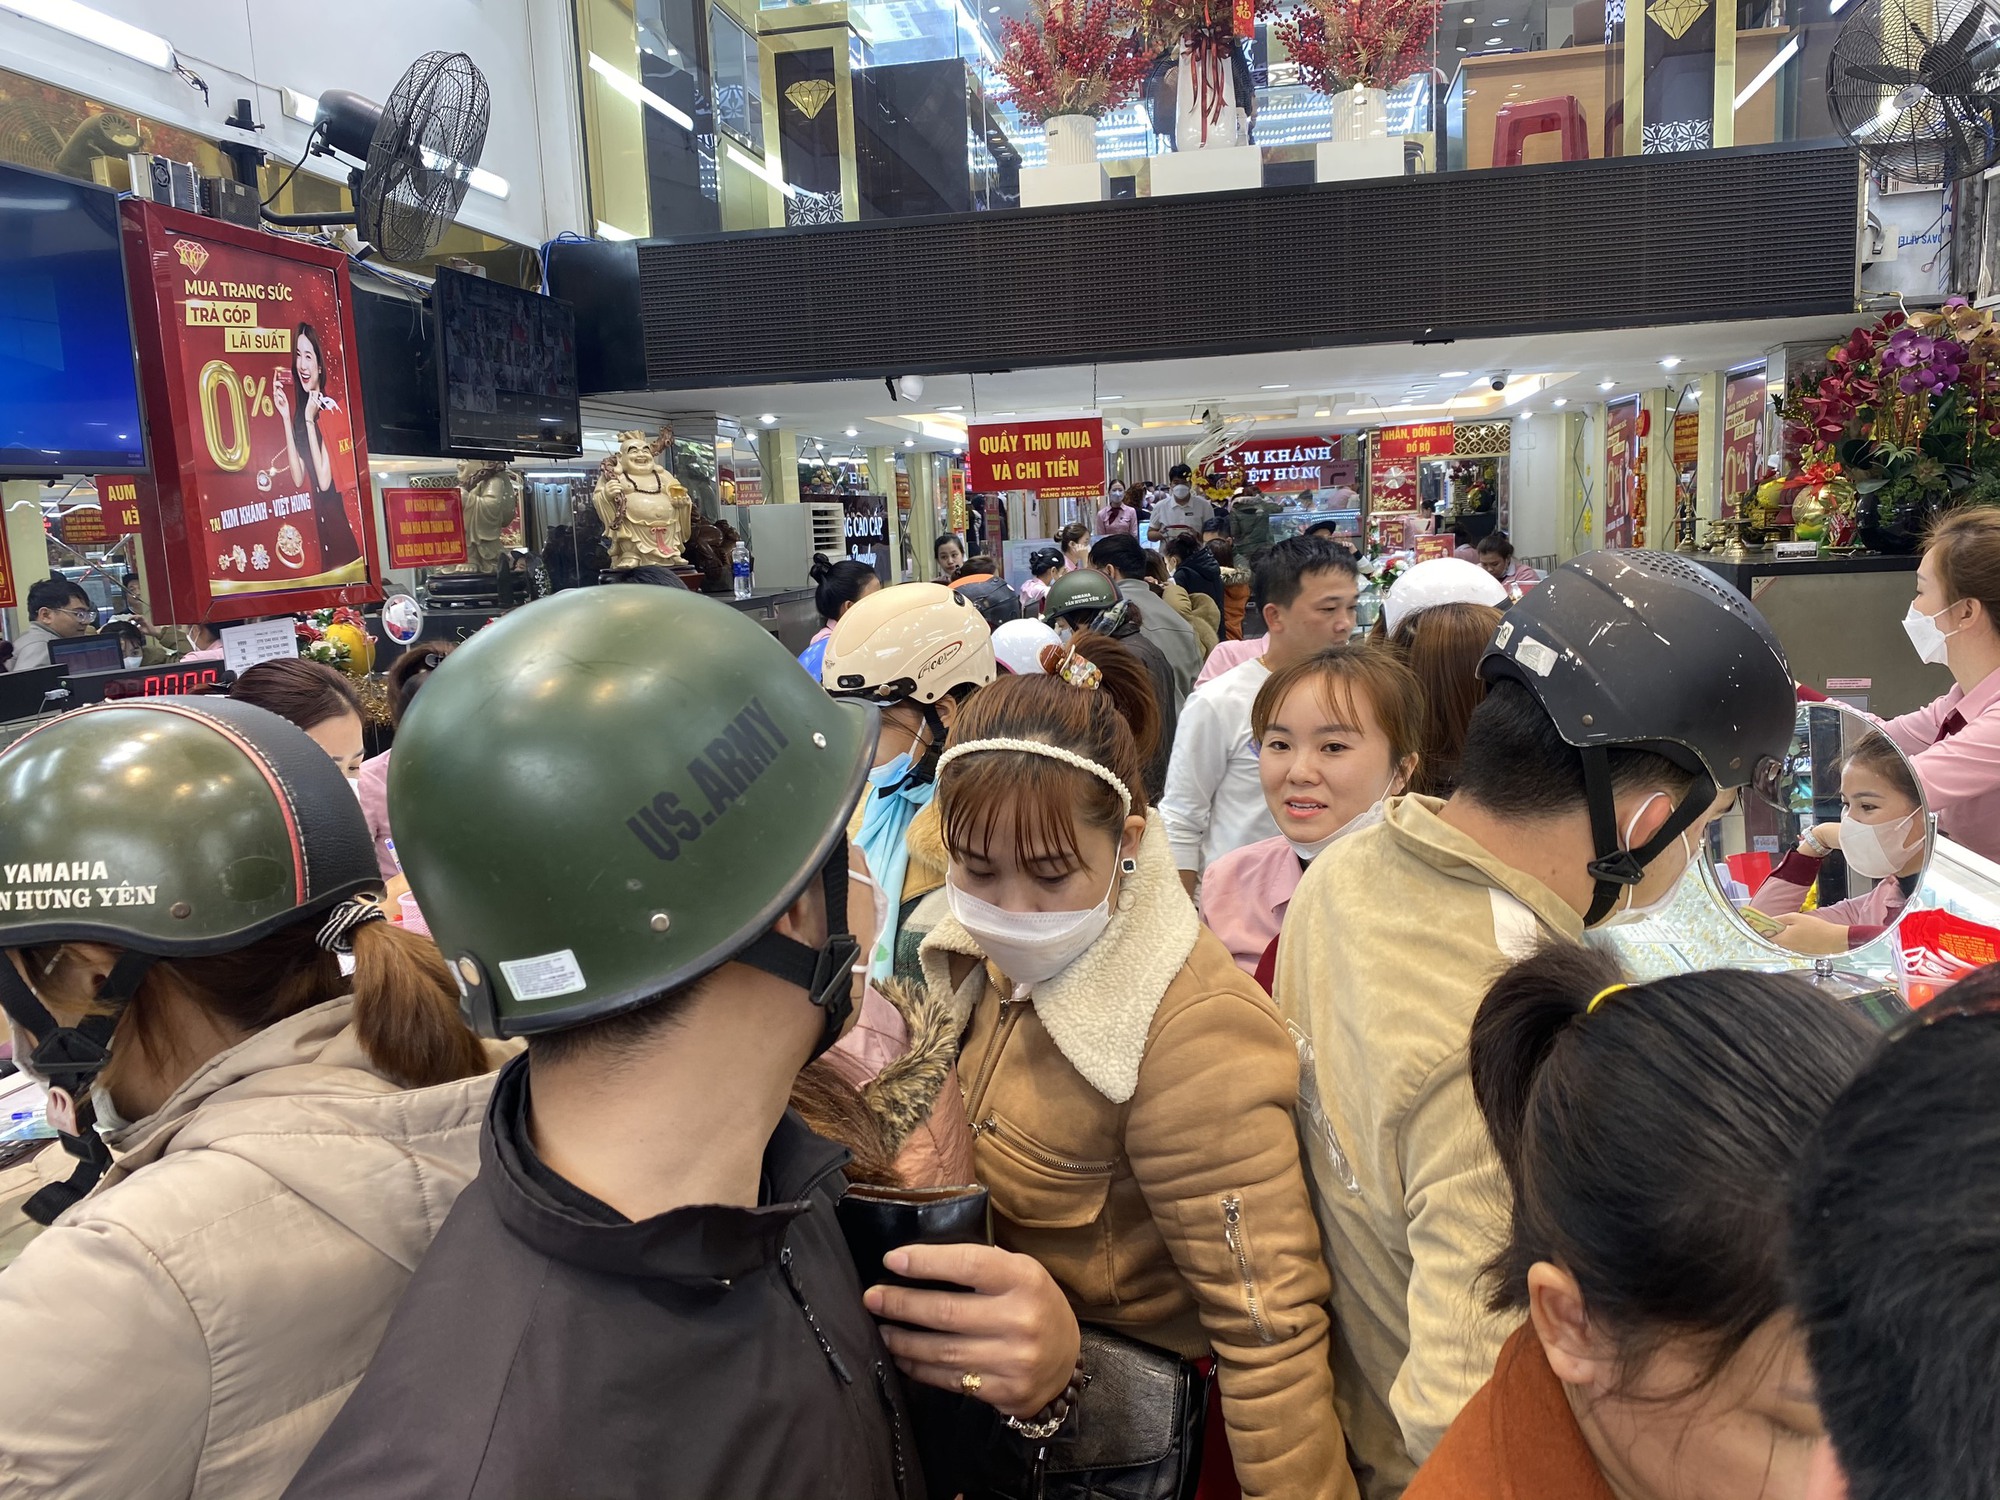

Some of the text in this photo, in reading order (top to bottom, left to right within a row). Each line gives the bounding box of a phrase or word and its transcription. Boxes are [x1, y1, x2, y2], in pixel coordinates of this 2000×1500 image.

[1898, 235, 1919, 246] AFTE
[185, 279, 293, 301] MUA TRANG SỨC
[191, 302, 251, 323] TRẢ GÓP
[232, 329, 285, 348] LÃI SUẤT
[199, 360, 275, 472] 0%
[979, 430, 1091, 455] QUẦY THU MUA
[1263, 445, 1332, 463] KHÁNH
[992, 454, 1079, 481] VÀ CHI TIỀN
[220, 508, 240, 529] KIM
[239, 501, 268, 525] KHÁNH
[272, 494, 290, 519] VIỆT
[290, 491, 311, 513] HÙNG
[853, 516, 868, 538] CAO
[3, 860, 109, 884] YAMAHA
[15, 888, 92, 911] HƯNG
[96, 880, 158, 907] YÊN
